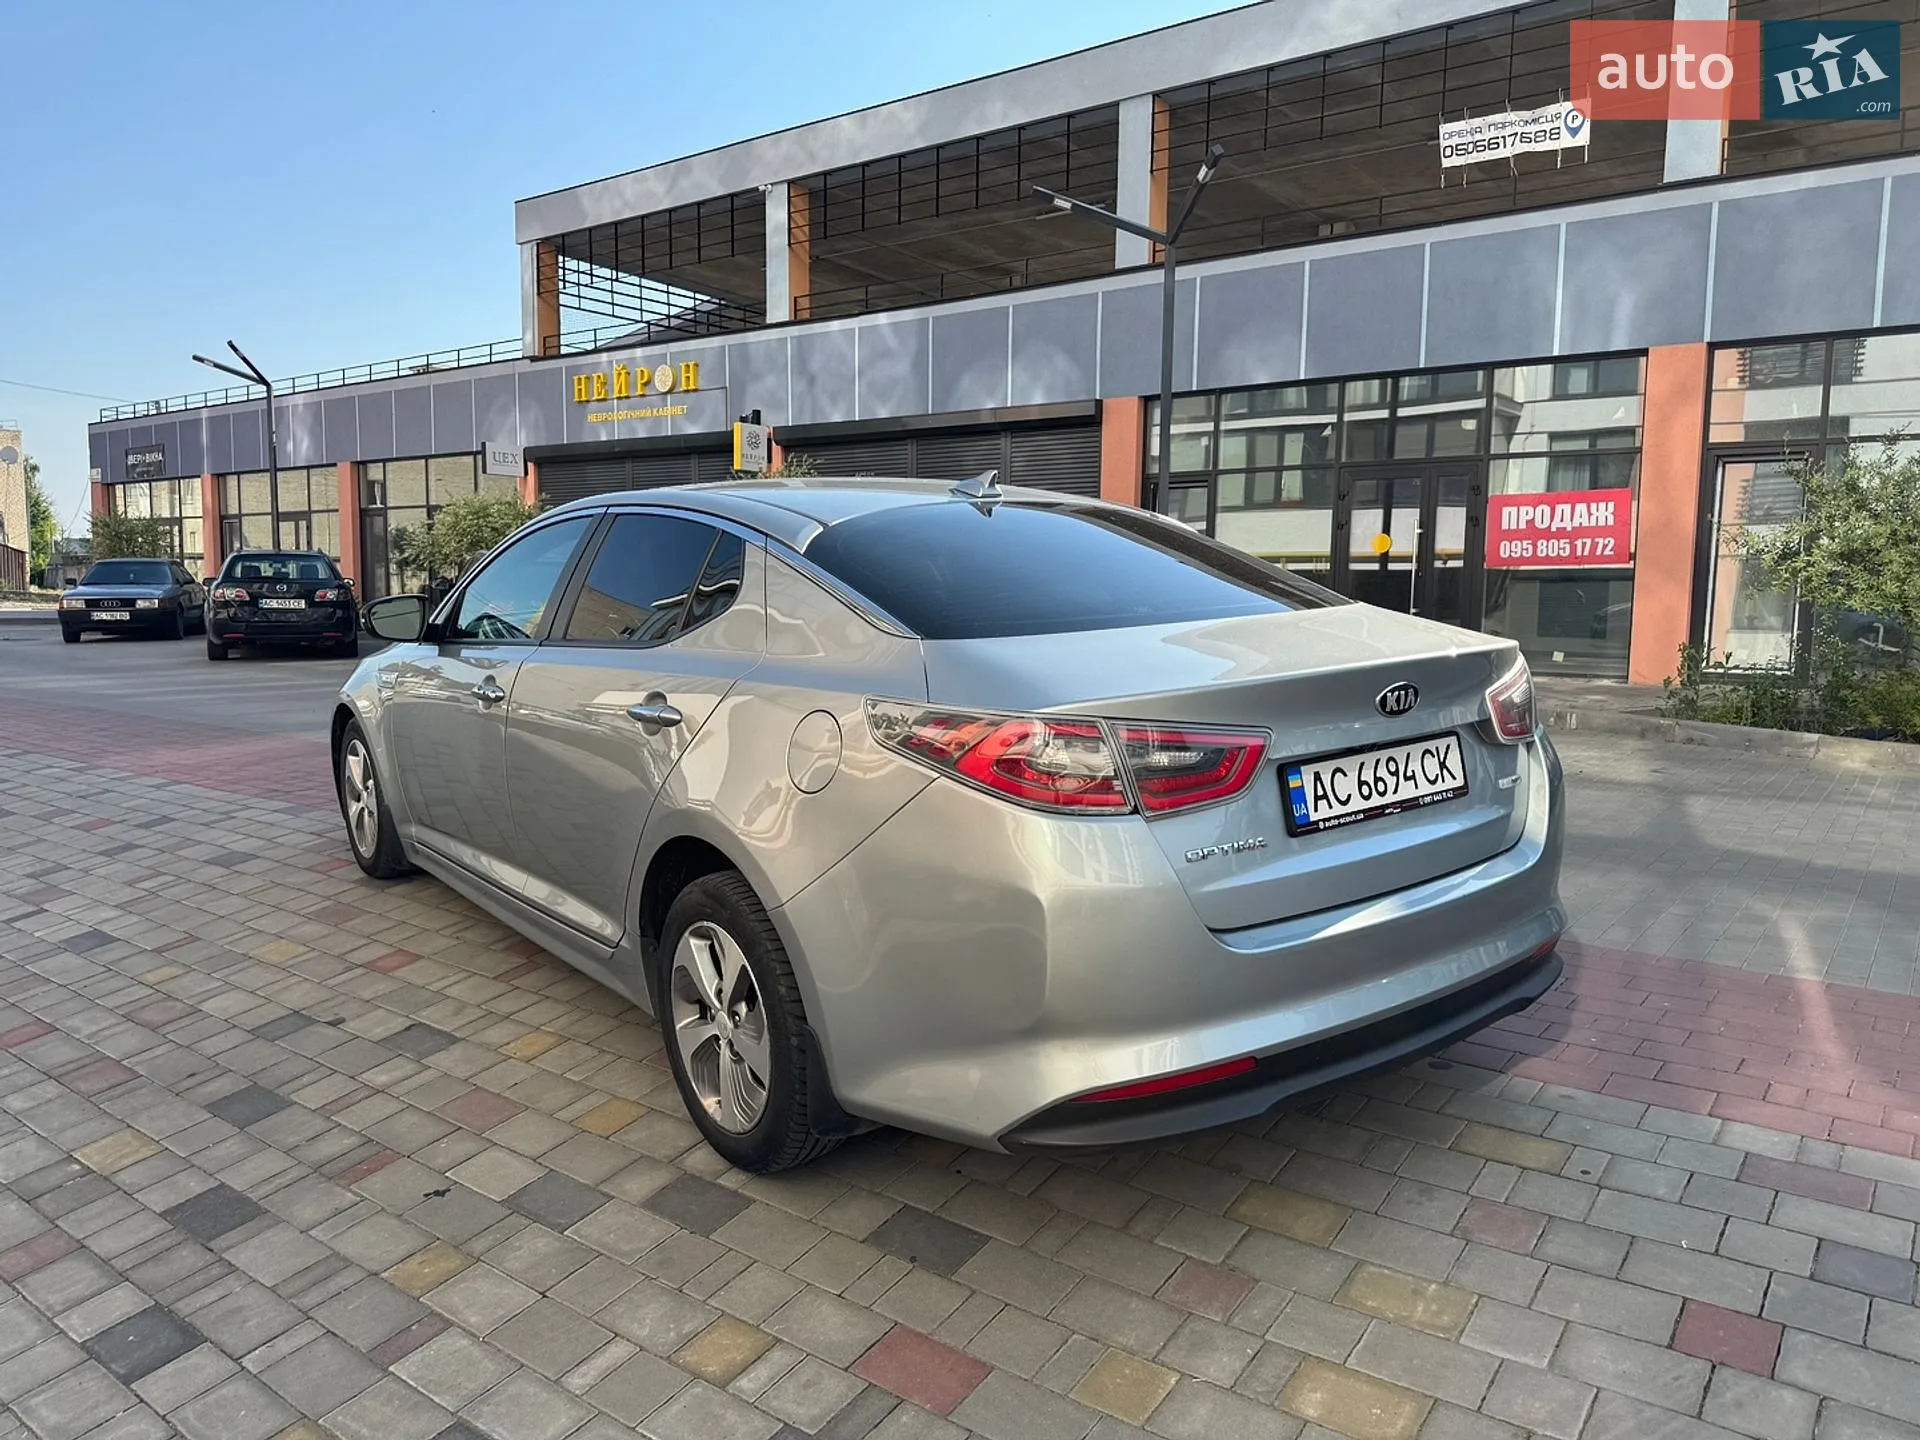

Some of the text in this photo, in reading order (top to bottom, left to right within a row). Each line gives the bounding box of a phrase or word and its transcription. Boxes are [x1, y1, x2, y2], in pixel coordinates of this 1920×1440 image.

[1488, 112, 1562, 133] ПАРКОМІСЦЯ
[1442, 126, 1561, 158] 0506617688
[573, 361, 699, 403] НЕЙРОН
[653, 404, 688, 417] КАБІНЕТ
[492, 450, 519, 465] ЦЕХ
[1501, 501, 1615, 531] ПРОДАЖ
[1500, 537, 1615, 558] 095 805 17 72
[1386, 688, 1415, 711] KIA
[1312, 743, 1457, 813] AC 6694 CK
[1293, 803, 1308, 817] UA
[1185, 837, 1267, 863] OPTIMA
